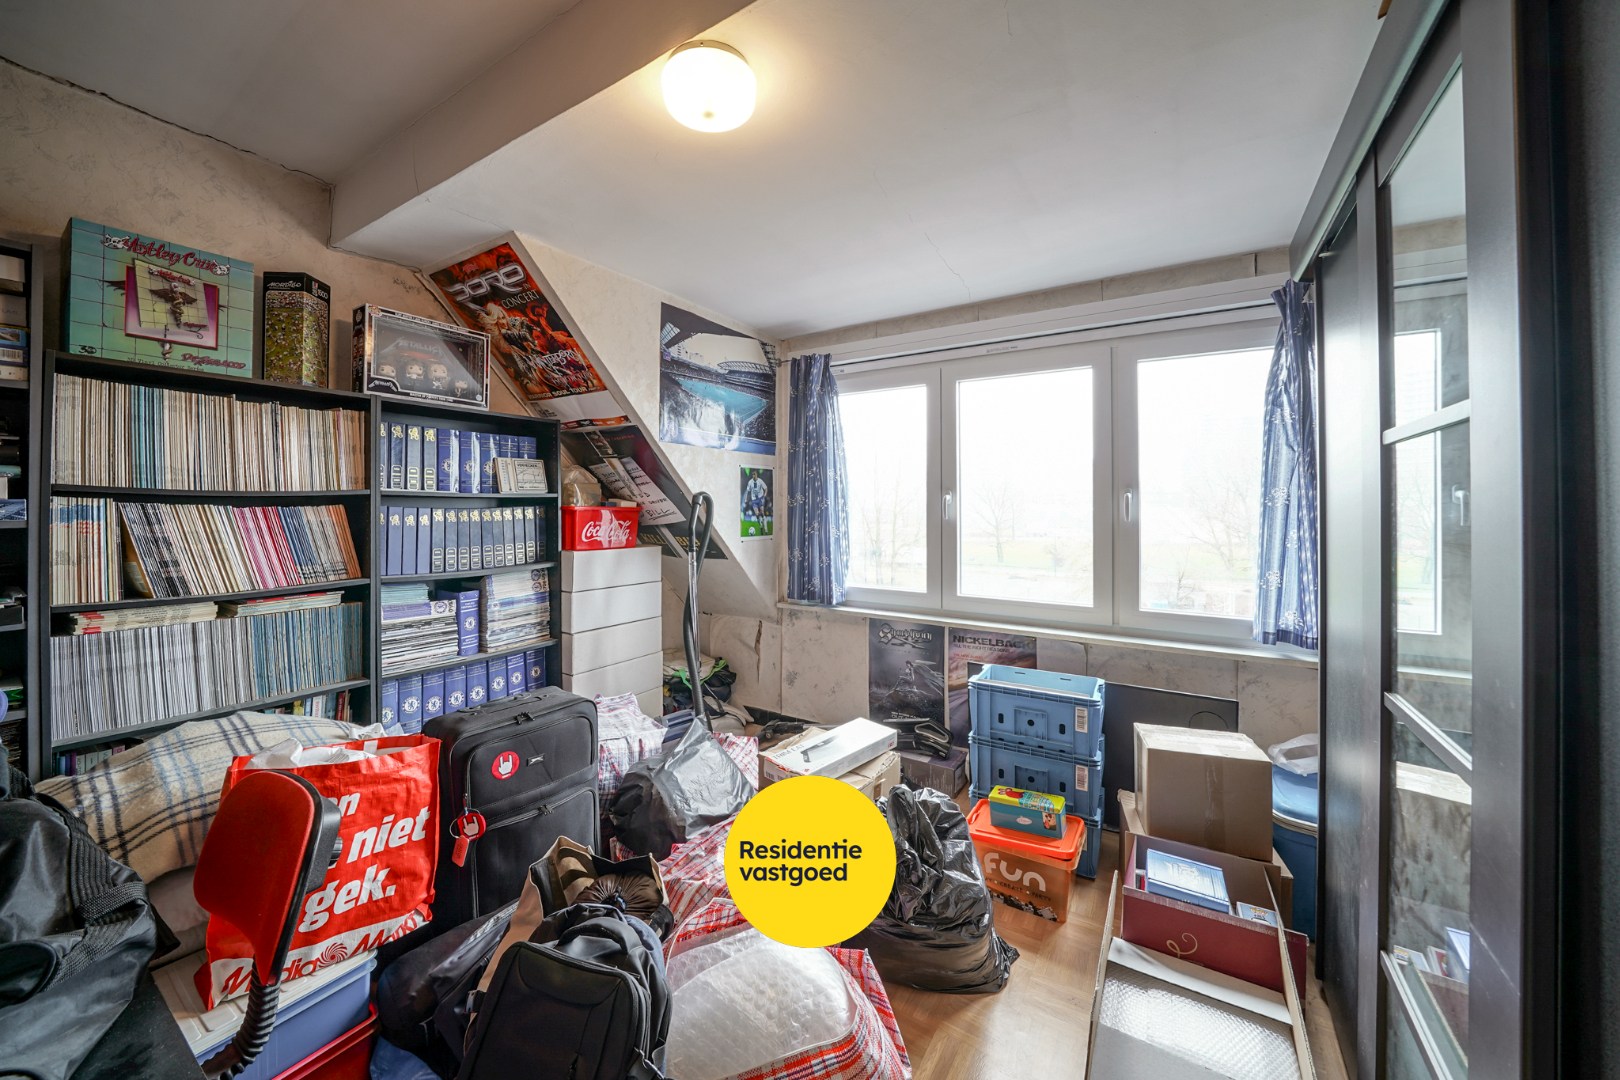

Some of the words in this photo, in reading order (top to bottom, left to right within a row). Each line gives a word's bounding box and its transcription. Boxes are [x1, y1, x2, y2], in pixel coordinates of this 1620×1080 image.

[501, 290, 540, 308] CONCERT
[552, 389, 570, 397] SOUL
[570, 386, 588, 395] TOUR
[645, 509, 670, 517] BILL
[346, 806, 431, 864] niet
[298, 864, 396, 933] gek.
